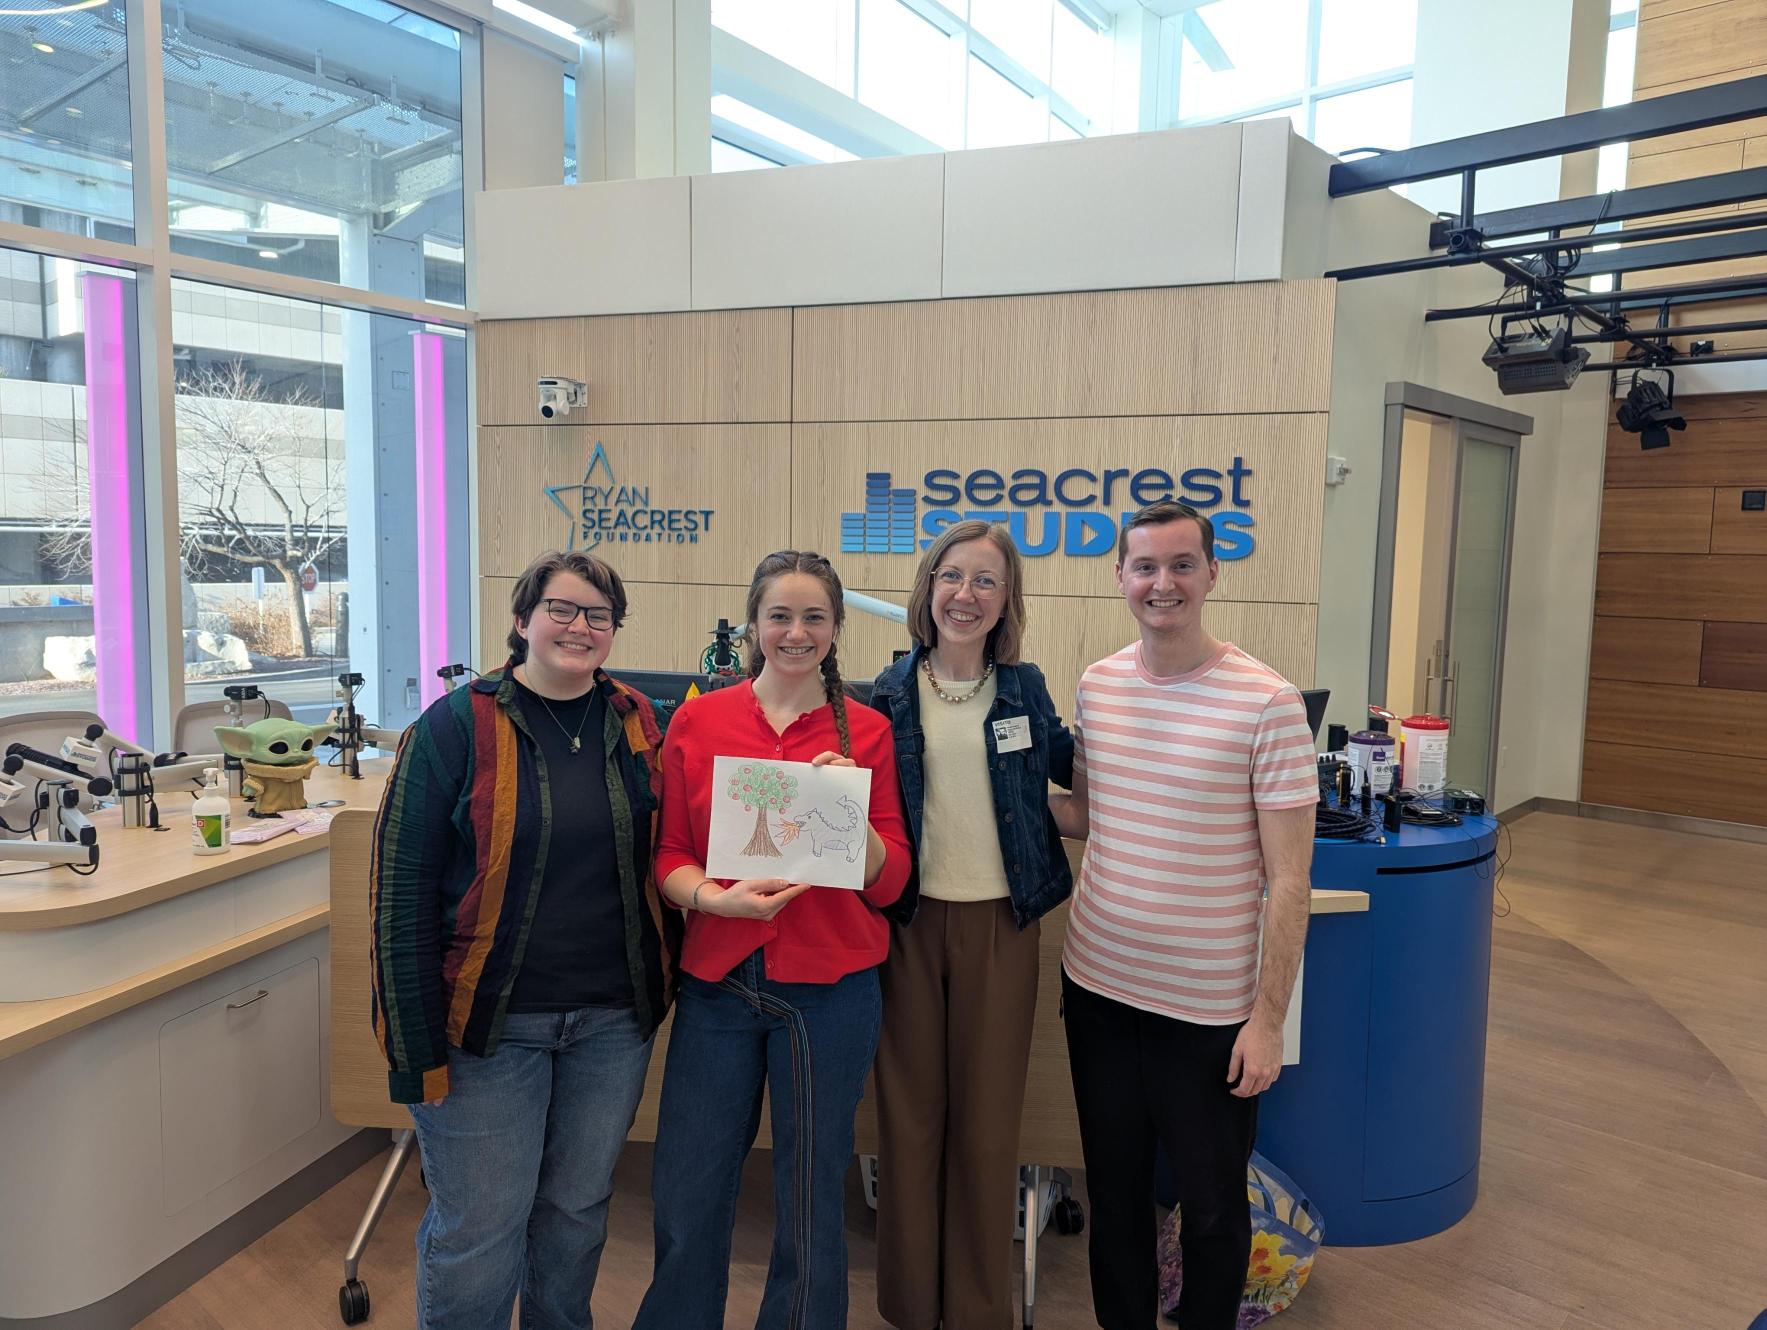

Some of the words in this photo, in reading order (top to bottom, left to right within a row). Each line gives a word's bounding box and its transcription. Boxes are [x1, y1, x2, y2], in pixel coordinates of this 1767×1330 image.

[920, 457, 1252, 508] seacrest
[582, 486, 649, 507] RYAN
[582, 509, 714, 531] SEACREST
[583, 532, 698, 543] FOUNDATION
[918, 509, 1255, 560] SUDS
